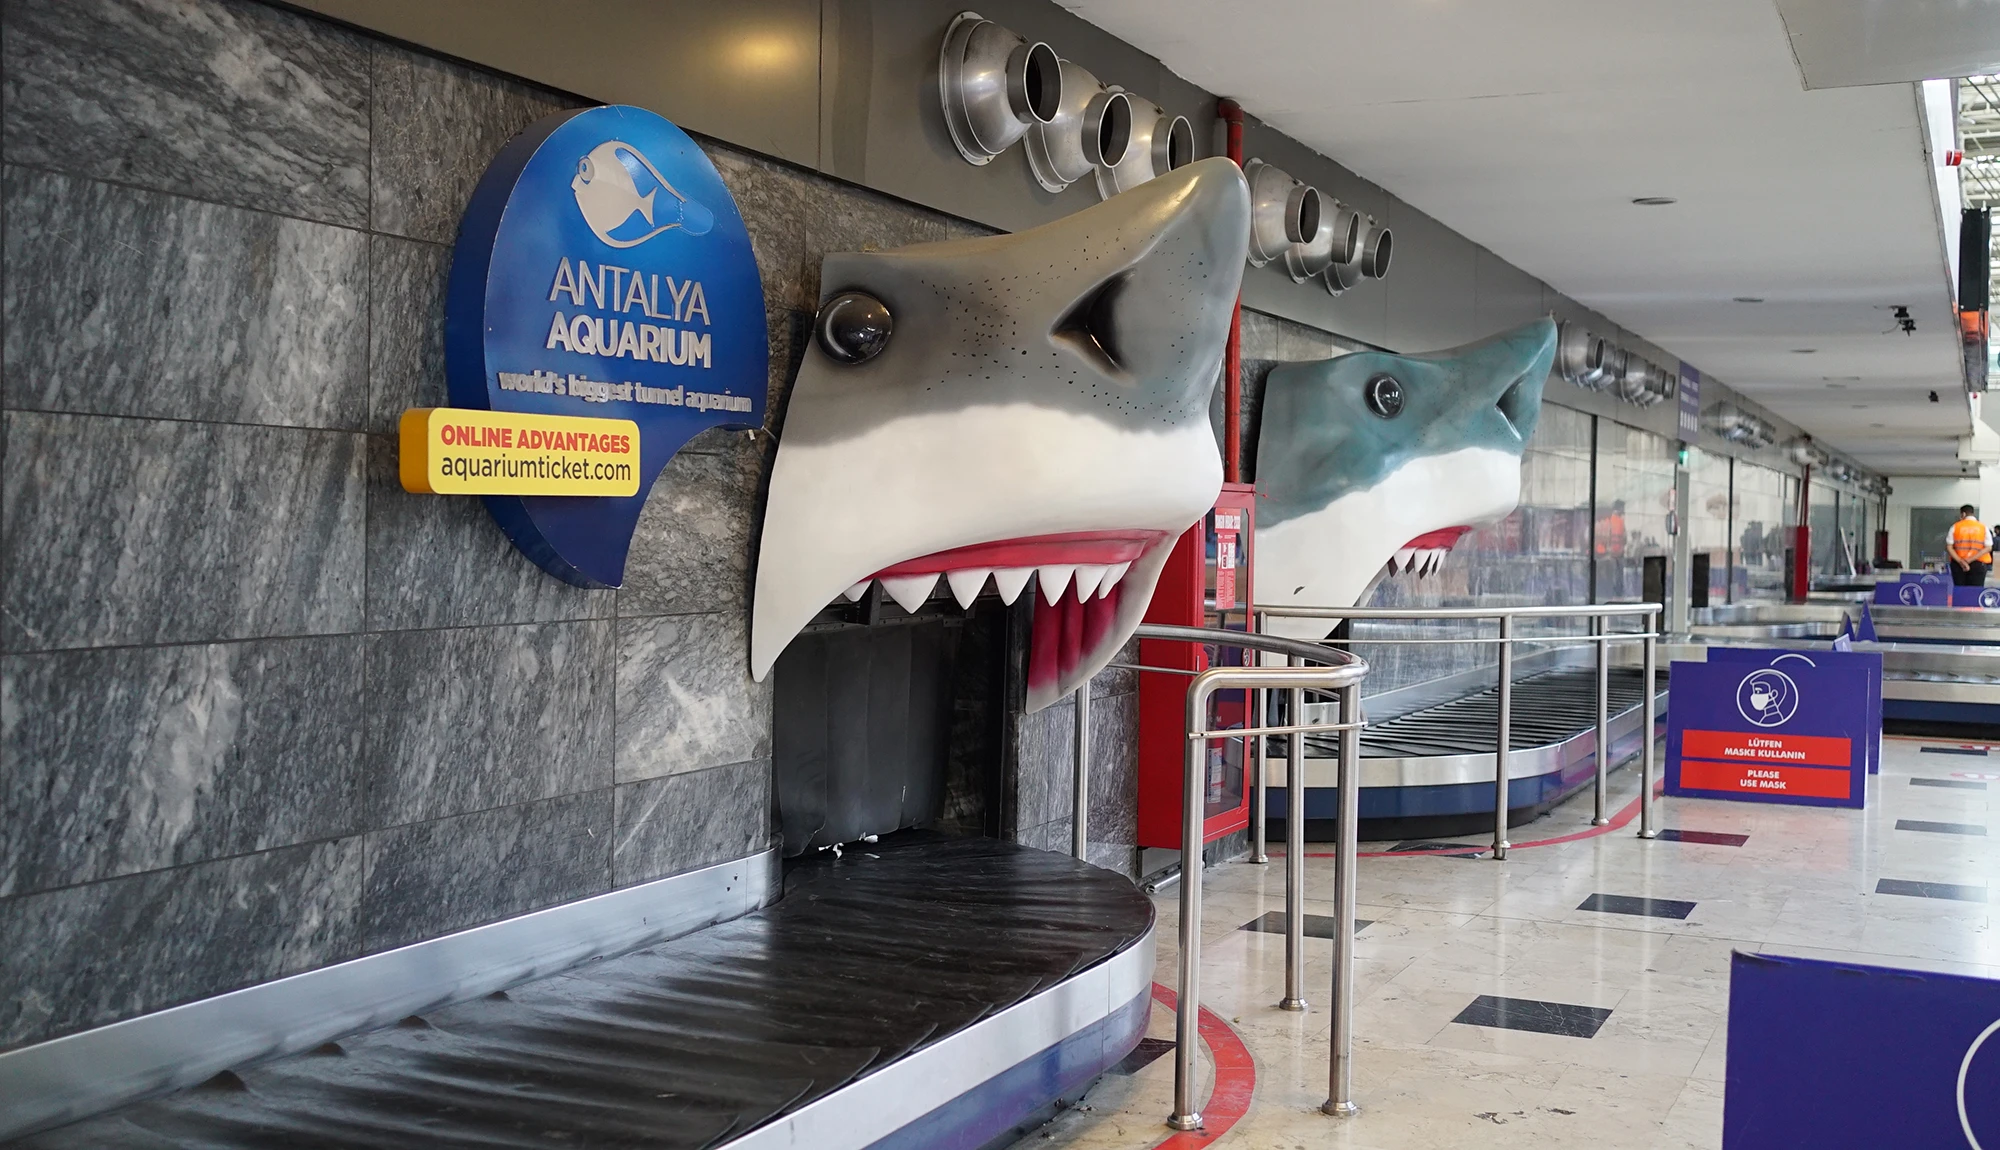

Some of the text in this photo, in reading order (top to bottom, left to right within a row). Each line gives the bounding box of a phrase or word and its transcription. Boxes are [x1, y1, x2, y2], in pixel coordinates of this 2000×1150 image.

[548, 256, 711, 326] ANTALYA
[546, 311, 712, 369] AQUARIUM
[498, 370, 753, 413] world's biggest tunnel aquarium
[441, 424, 631, 455] ONLINE ADVANTAGES
[441, 453, 631, 482] aquariumticket.com
[1724, 747, 1806, 760] MASKE KULLANIN
[1748, 737, 1783, 748] LÜTFEN
[1740, 779, 1787, 789] USE MASK
[1747, 769, 1780, 779] PLEASE
